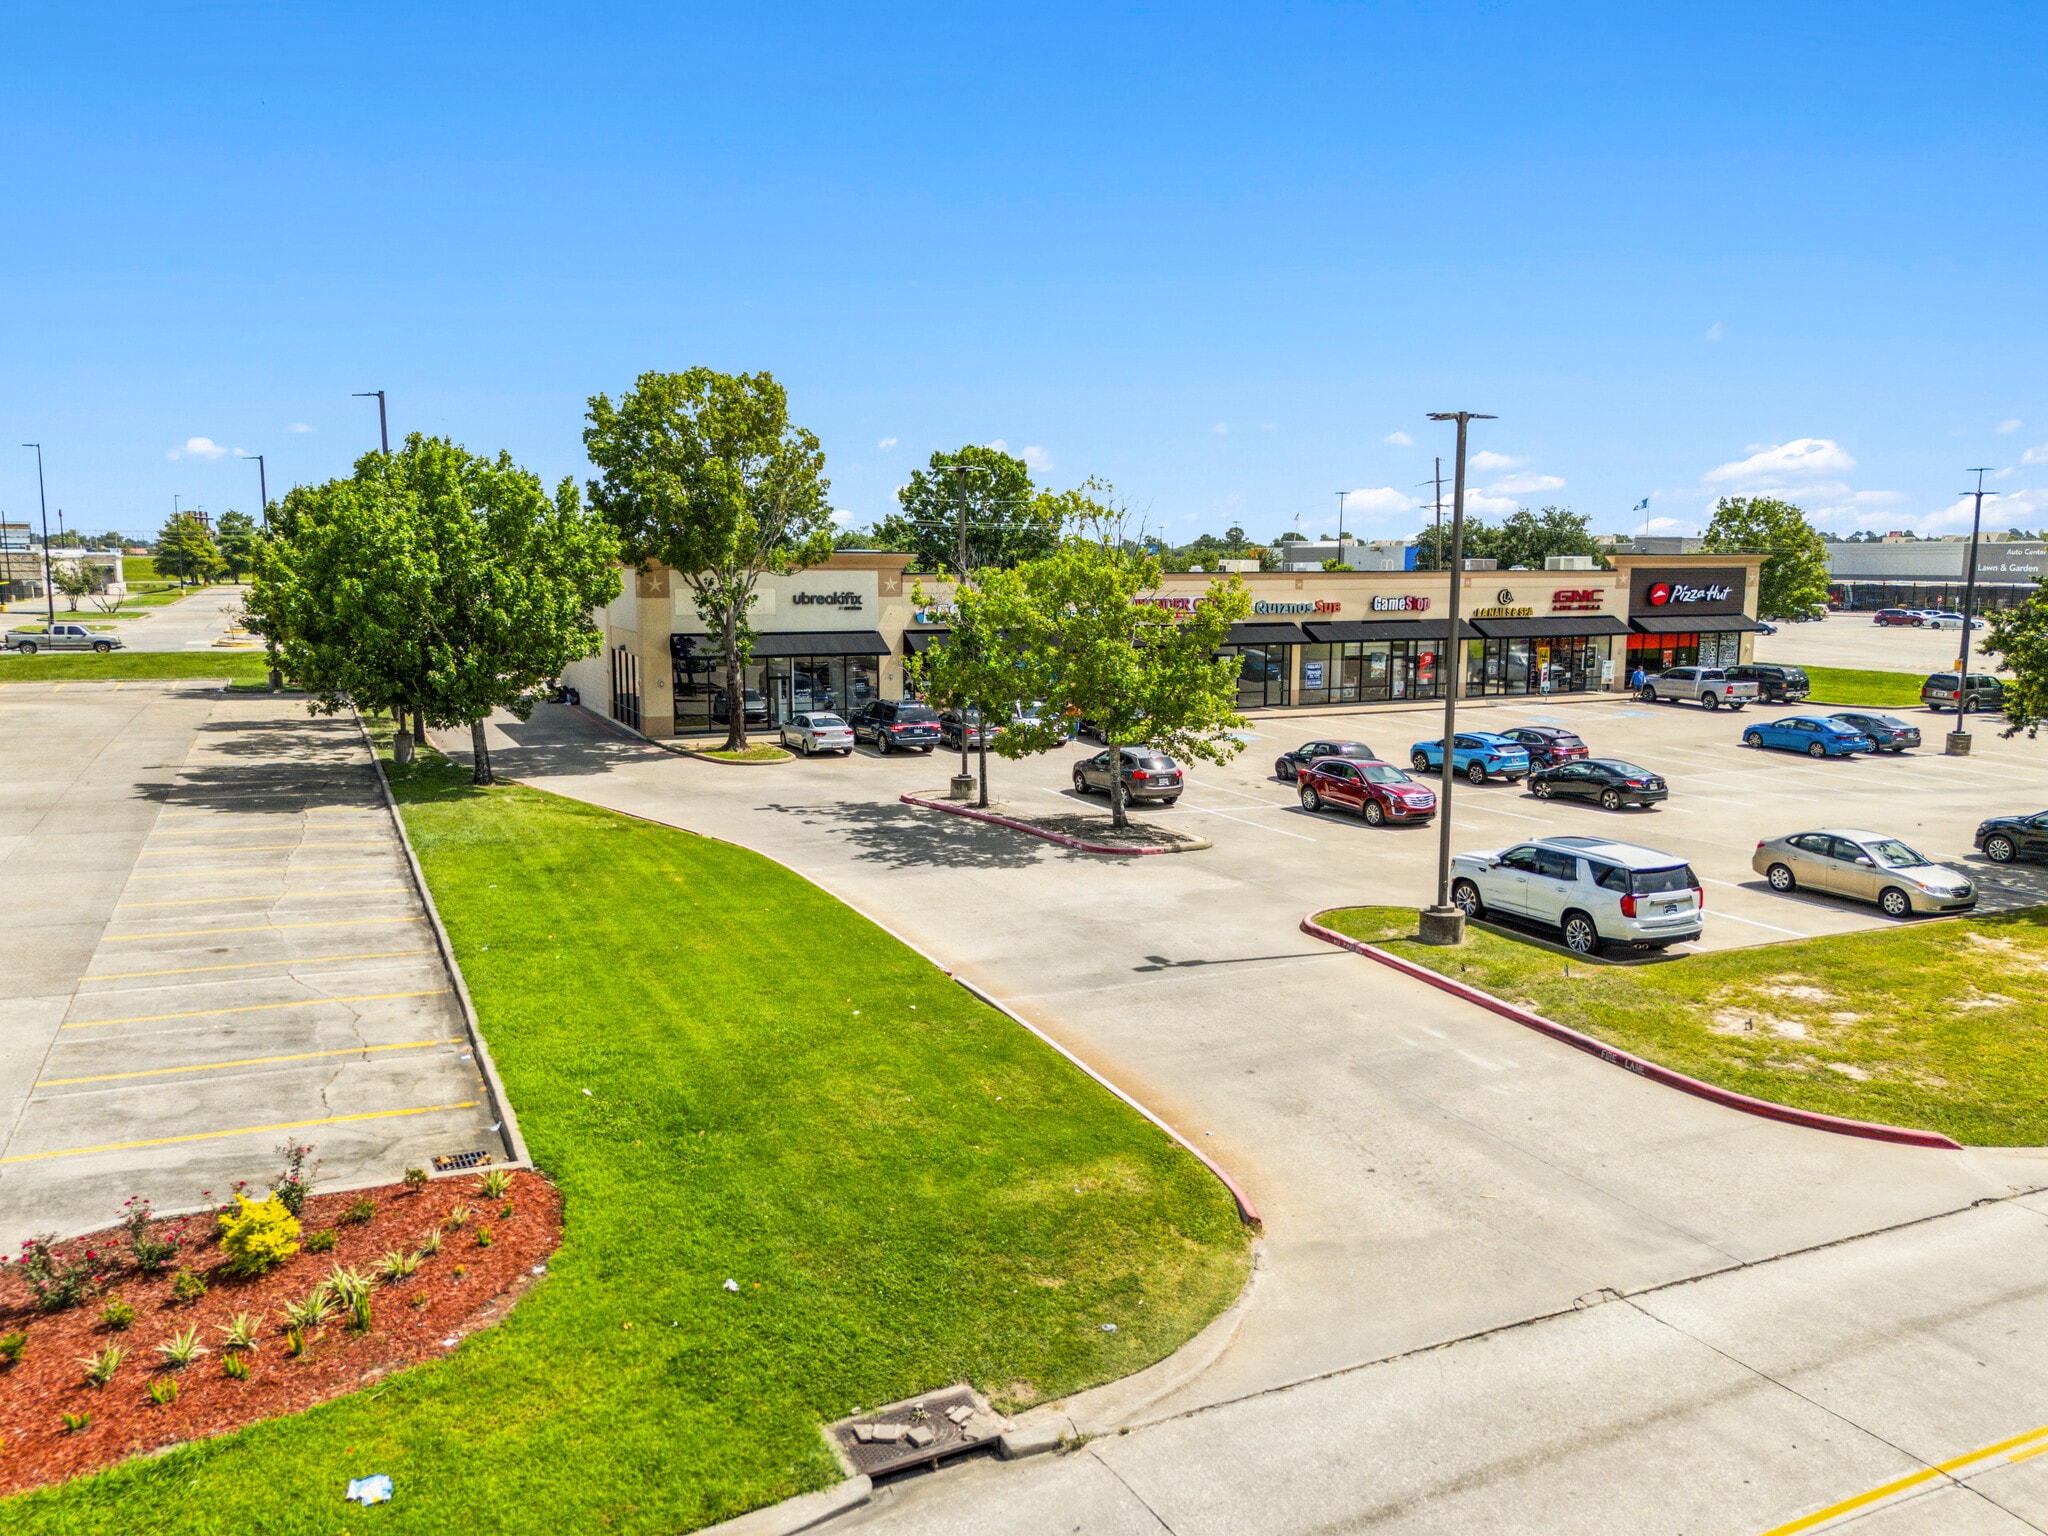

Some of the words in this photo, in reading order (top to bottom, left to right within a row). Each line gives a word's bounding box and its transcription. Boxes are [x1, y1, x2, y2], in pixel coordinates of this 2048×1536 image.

[1999, 564, 2007, 572] &
[2008, 564, 2039, 572] Garden
[793, 592, 863, 605] ubreakifix
[1552, 589, 1604, 603] GNC
[1670, 585, 1705, 603] Pizza
[1705, 584, 1733, 602] Hut
[1372, 595, 1431, 612] GameStop
[1601, 1051, 1617, 1064] FIRE
[1624, 1059, 1645, 1075] LANE
